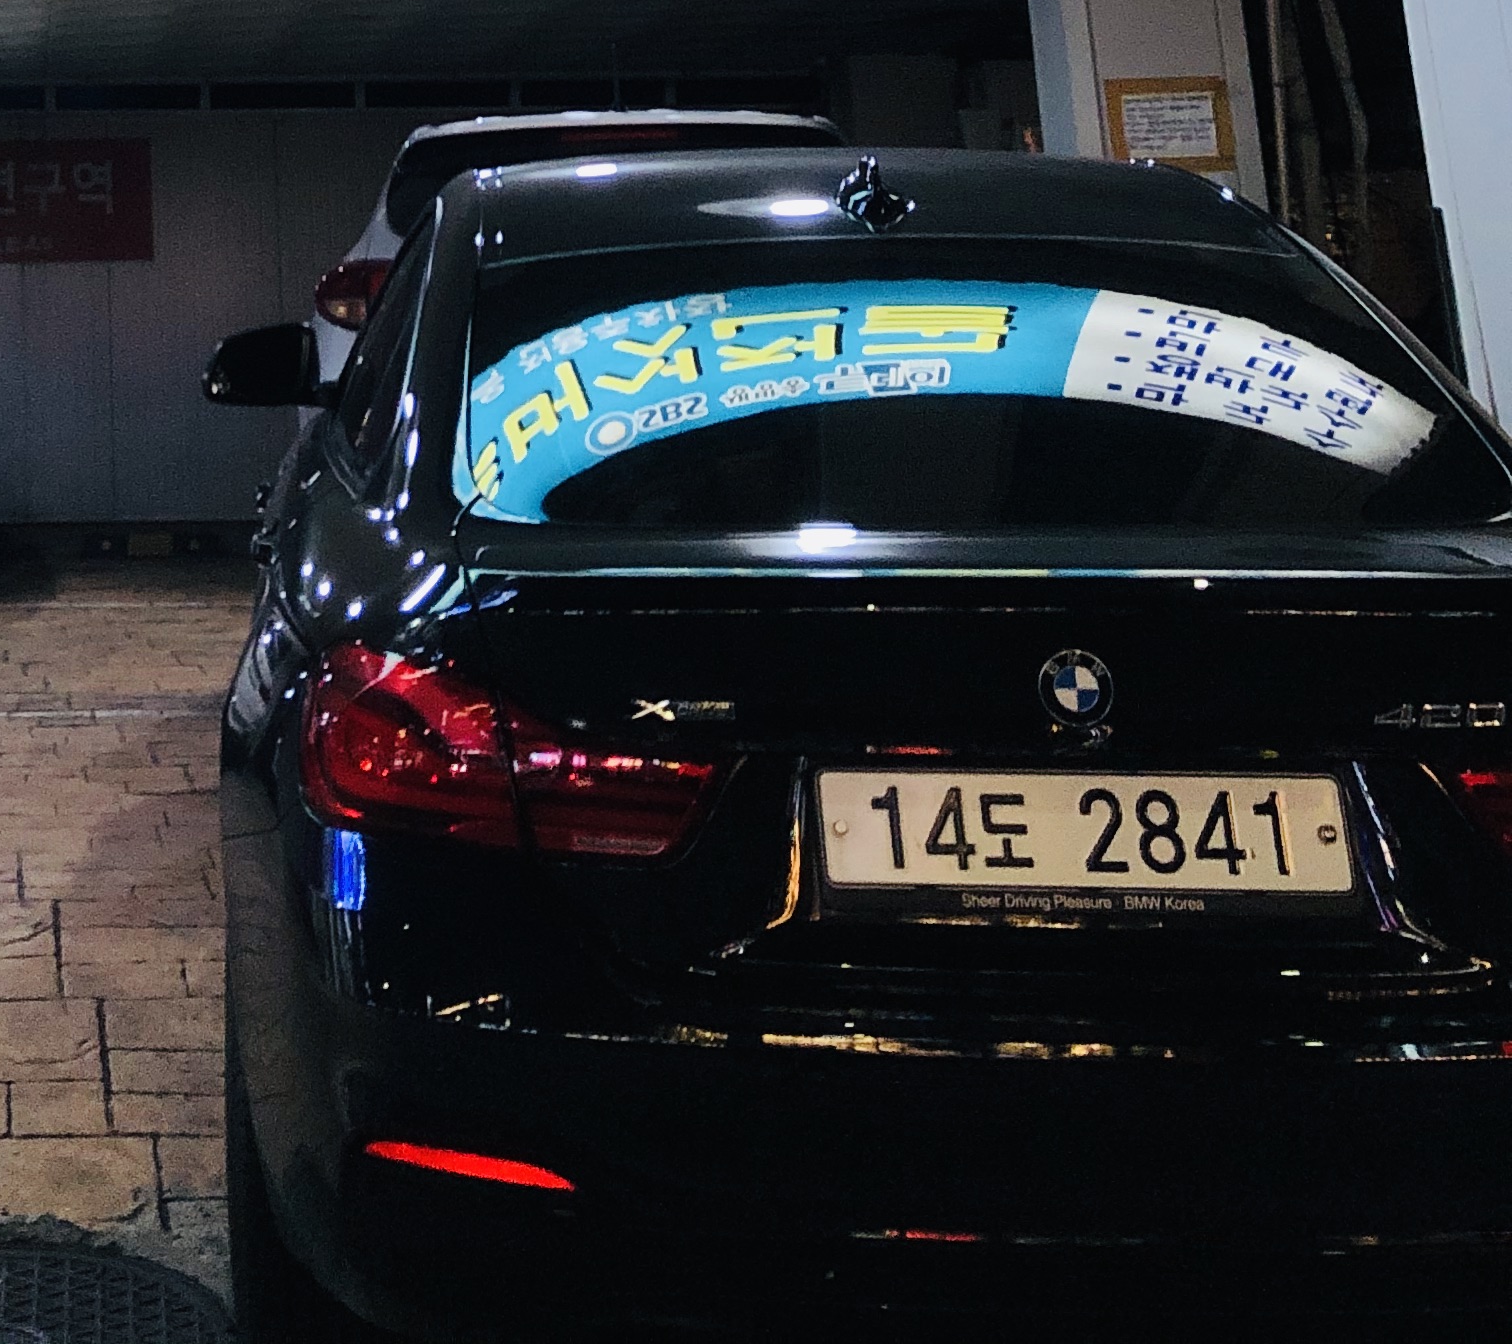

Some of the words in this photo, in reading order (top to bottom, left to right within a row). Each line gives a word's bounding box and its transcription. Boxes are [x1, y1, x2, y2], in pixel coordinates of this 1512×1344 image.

[870, 785, 1035, 871] 14도
[1078, 788, 1292, 877] 2841
[961, 892, 1001, 909] Sheer
[1004, 893, 1051, 912] Driving
[1053, 894, 1113, 910] Pleasure
[1123, 895, 1161, 911] BMW
[1164, 896, 1205, 911] Korea
